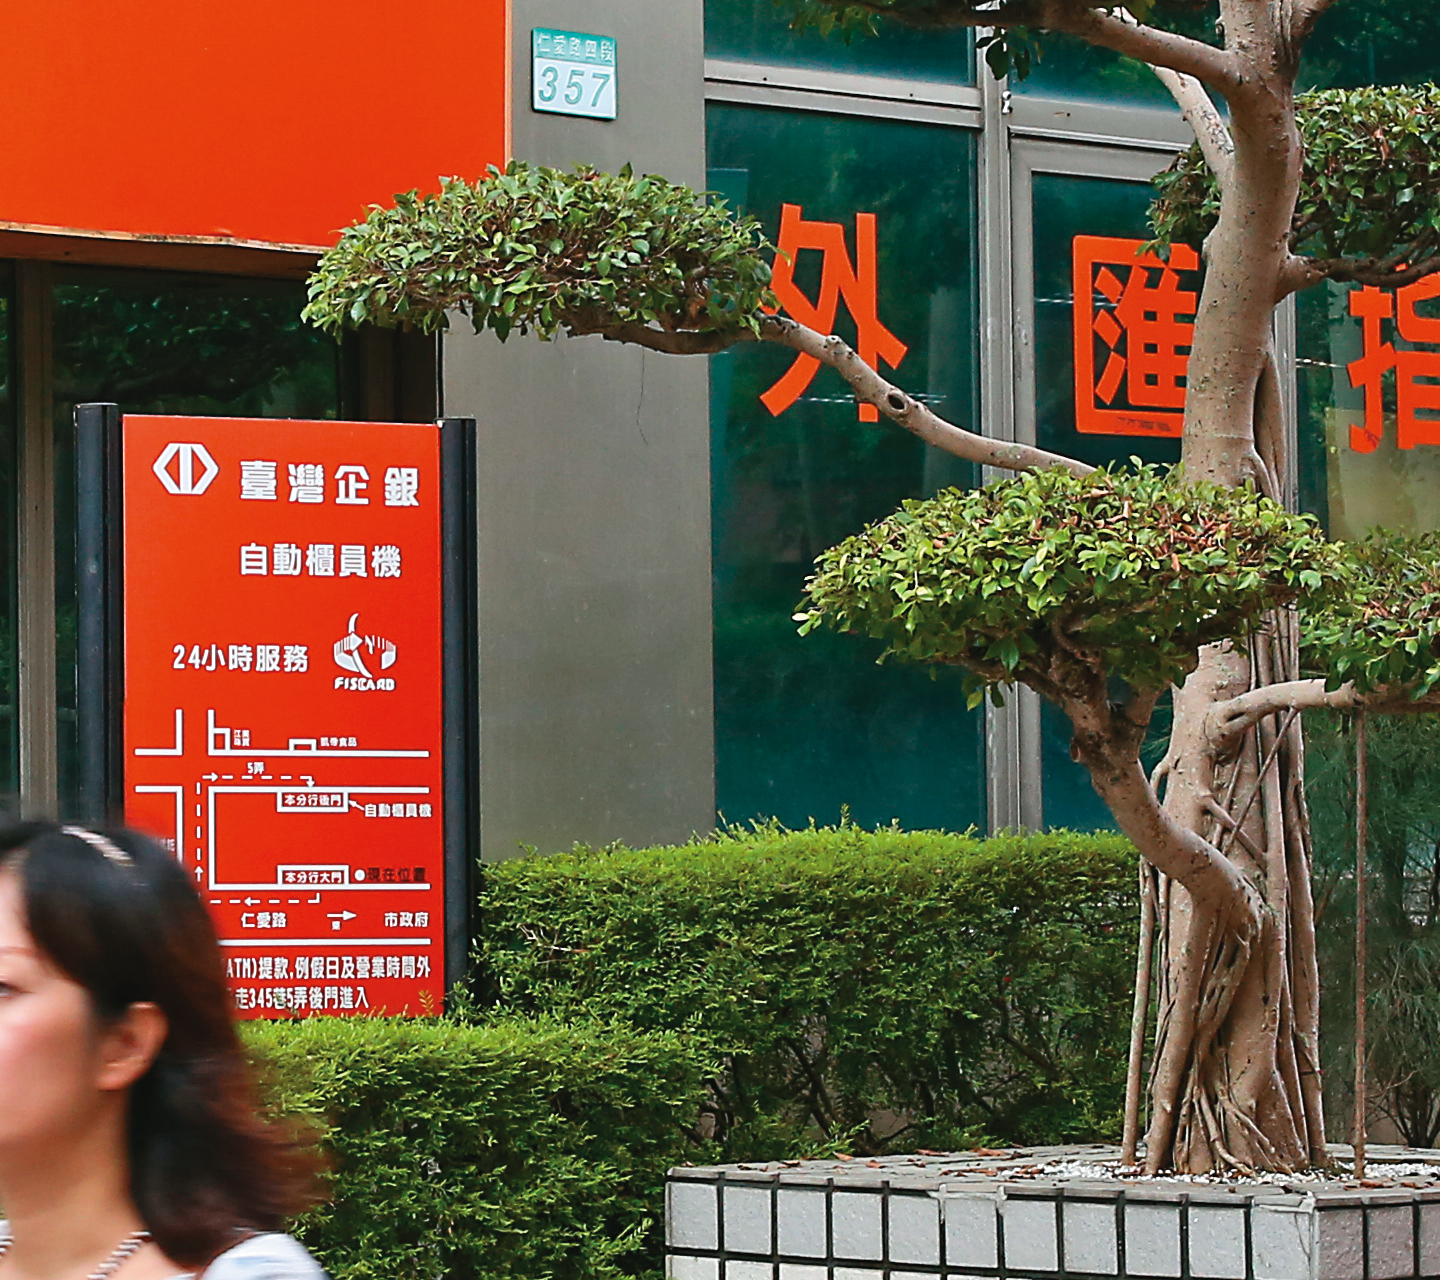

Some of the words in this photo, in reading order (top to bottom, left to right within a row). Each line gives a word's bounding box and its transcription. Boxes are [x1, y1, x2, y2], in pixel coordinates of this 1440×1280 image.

[538, 66, 611, 107] 357
[240, 460, 419, 506] 臺灣企銀
[240, 542, 401, 578] 自動櫃員機
[173, 644, 308, 673] 24小時服務
[334, 676, 396, 691] FISCARD
[284, 794, 342, 807] 本分行後門
[285, 871, 342, 884] 本分行大門
[241, 912, 287, 928] 仁愛路
[384, 912, 428, 928] 市政府
[224, 956, 431, 980] ATM)提款,例假日及營業時間外
[226, 986, 369, 1009] 走345巷5弄後門進入
